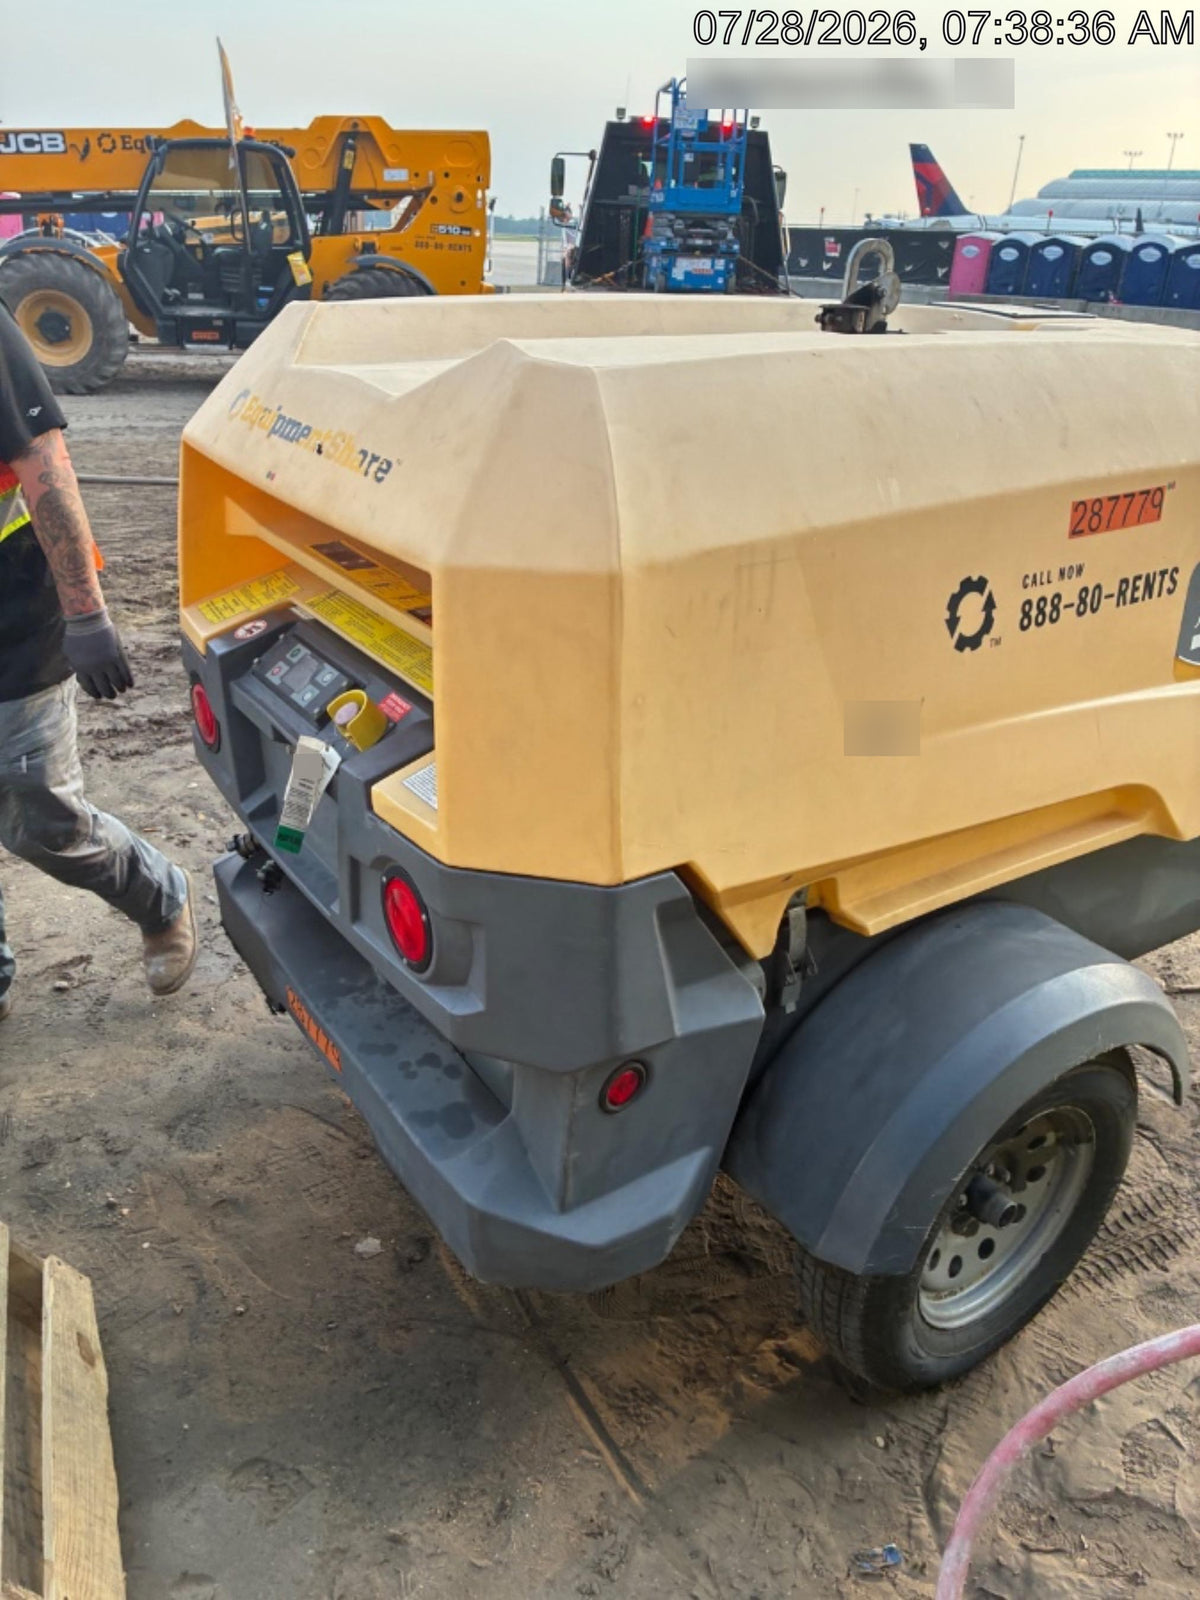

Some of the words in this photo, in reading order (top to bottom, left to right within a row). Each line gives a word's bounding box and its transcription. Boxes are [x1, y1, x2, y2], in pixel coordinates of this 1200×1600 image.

[0, 132, 66, 153] JCB
[1071, 487, 1164, 537] 287779
[1022, 570, 1053, 589] CALL
[1058, 562, 1085, 582] NOW
[1019, 566, 1180, 632] 888-80-RENTS
